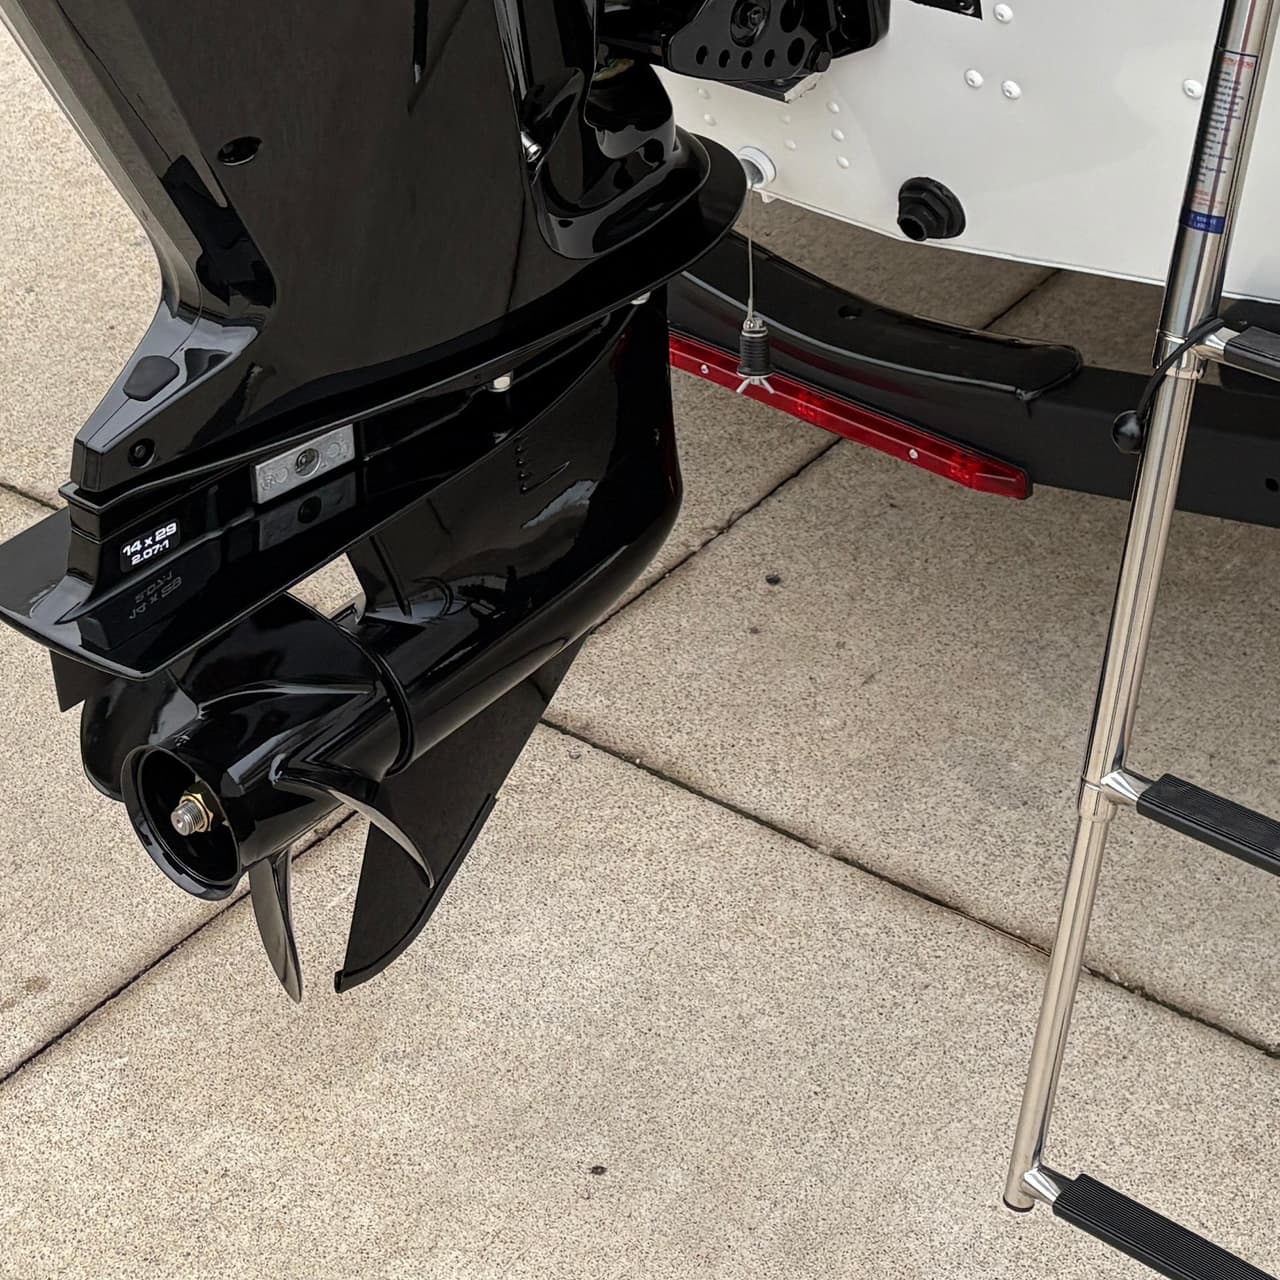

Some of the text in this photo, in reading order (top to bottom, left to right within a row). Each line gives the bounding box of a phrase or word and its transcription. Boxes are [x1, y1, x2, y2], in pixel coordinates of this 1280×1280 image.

[122, 540, 142, 556] 14
[155, 522, 177, 542] 29
[131, 539, 170, 566] 2.07:1
